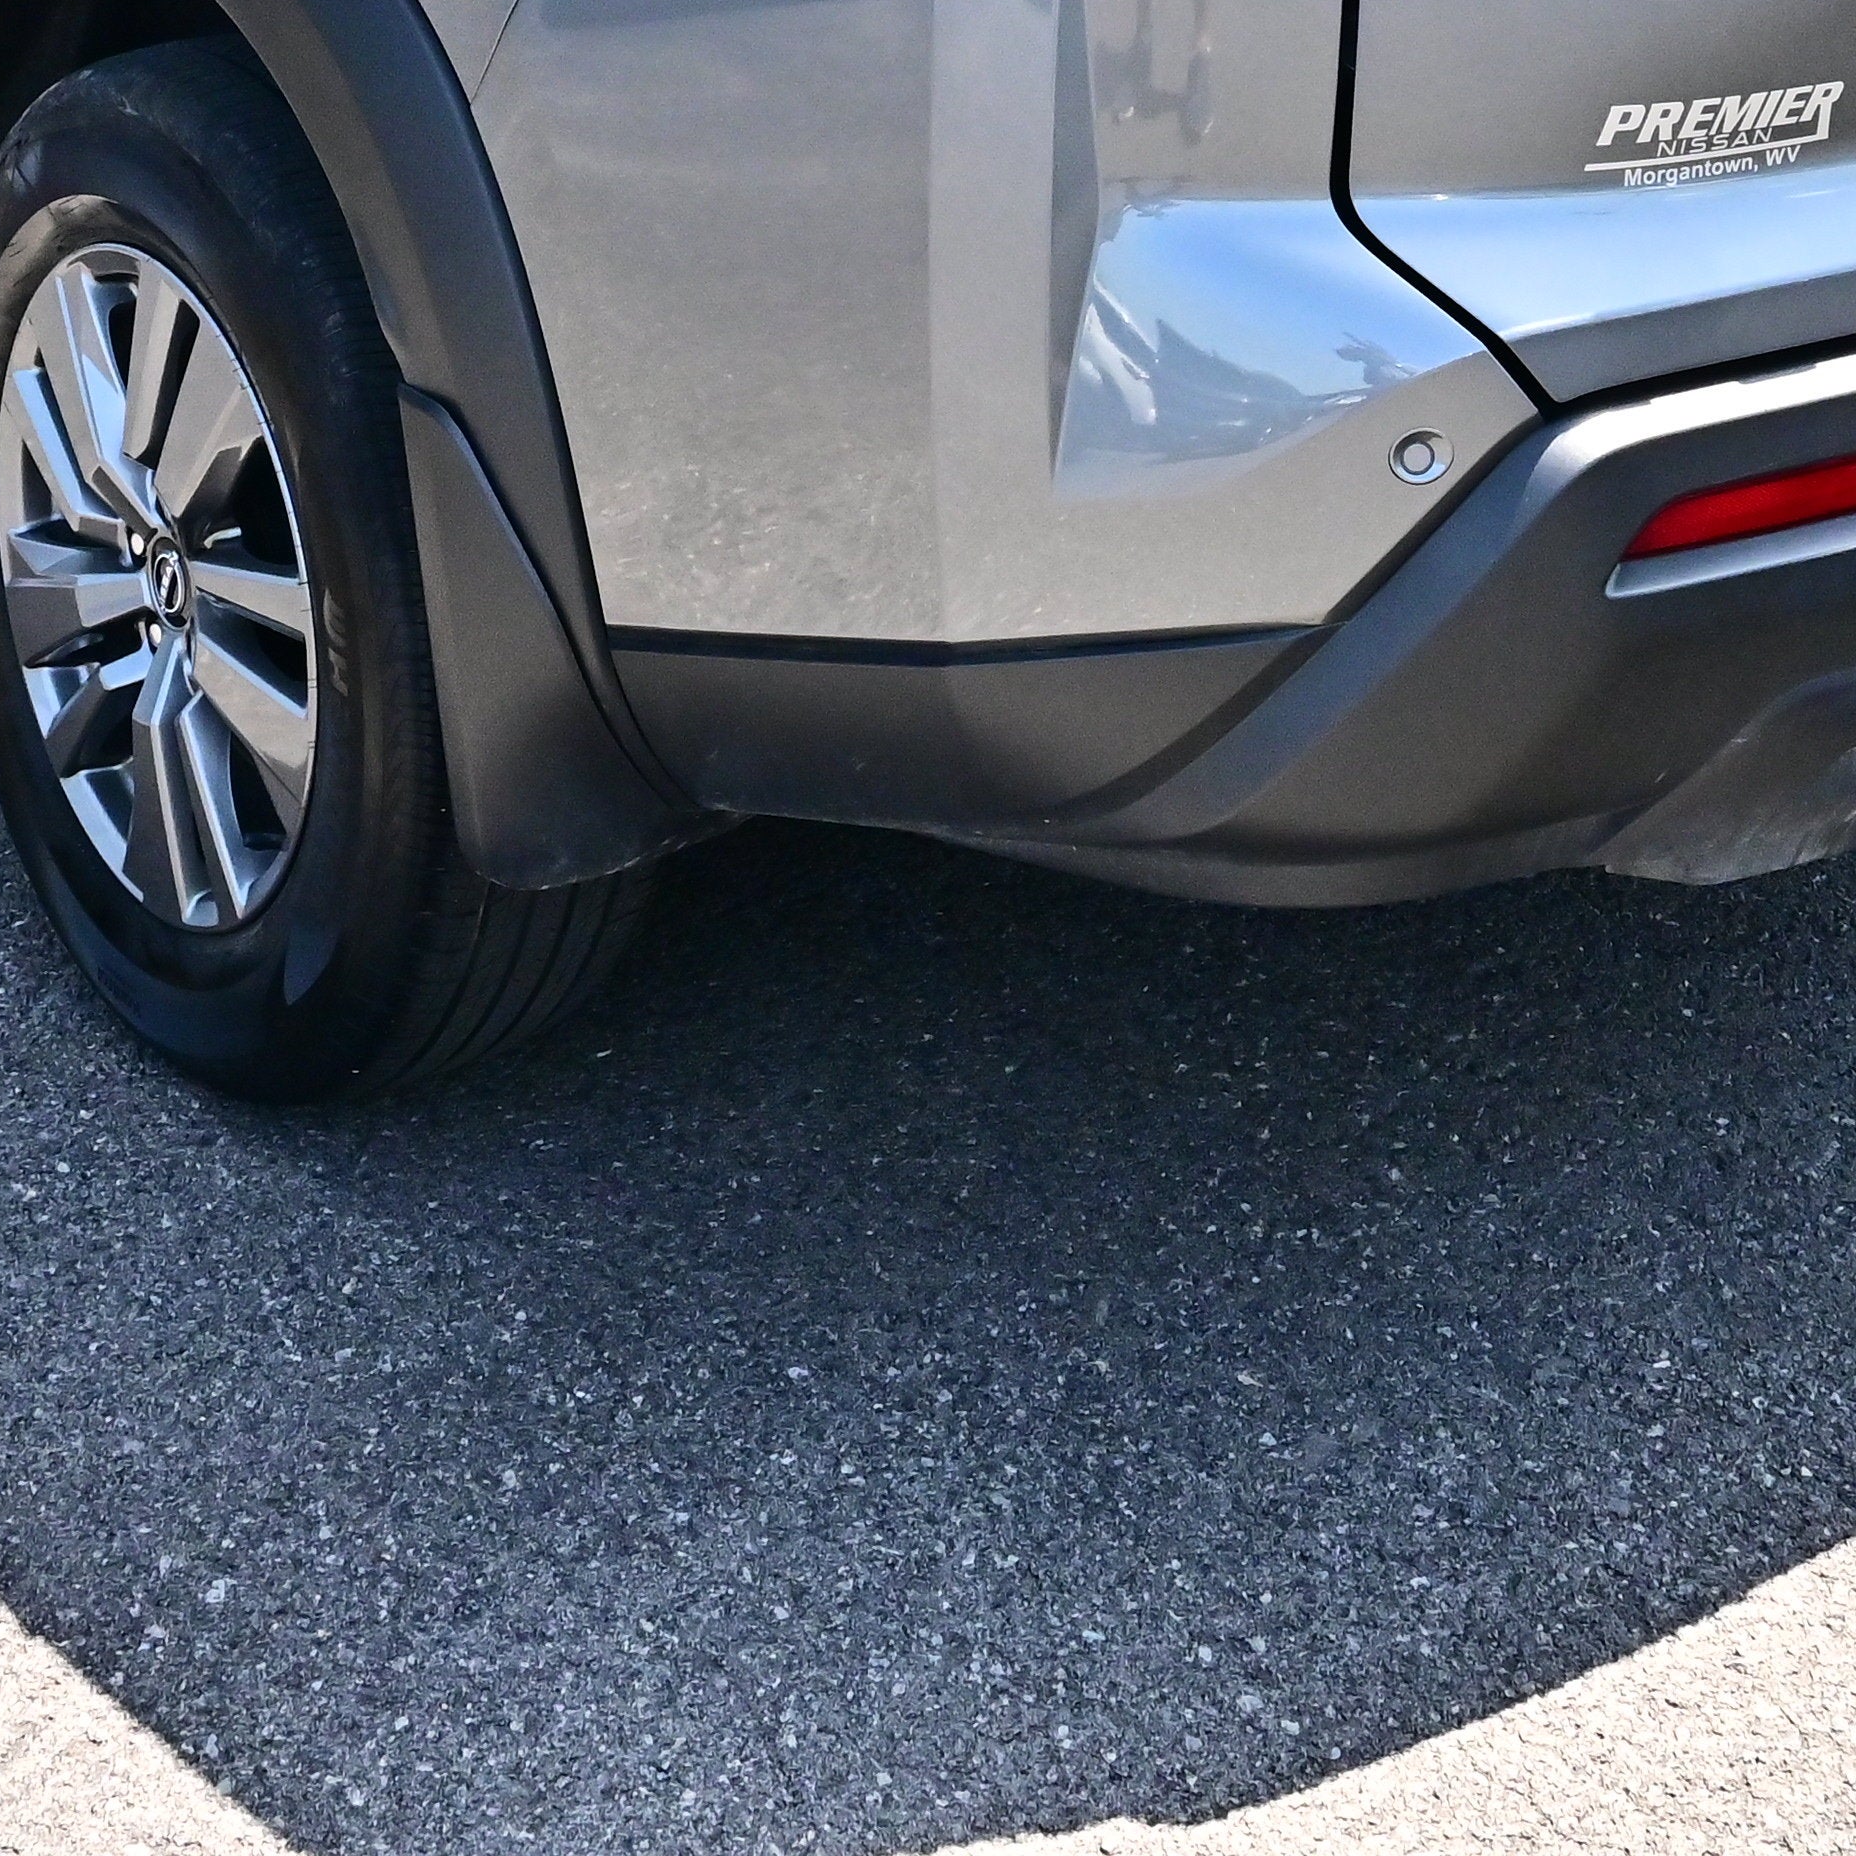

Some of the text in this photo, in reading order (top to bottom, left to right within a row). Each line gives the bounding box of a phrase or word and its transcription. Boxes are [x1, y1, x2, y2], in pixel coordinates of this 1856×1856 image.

[1595, 81, 1844, 147] PREMIER
[1656, 128, 1773, 158] NISSAN
[1623, 145, 1802, 188] Morgantown, WV
